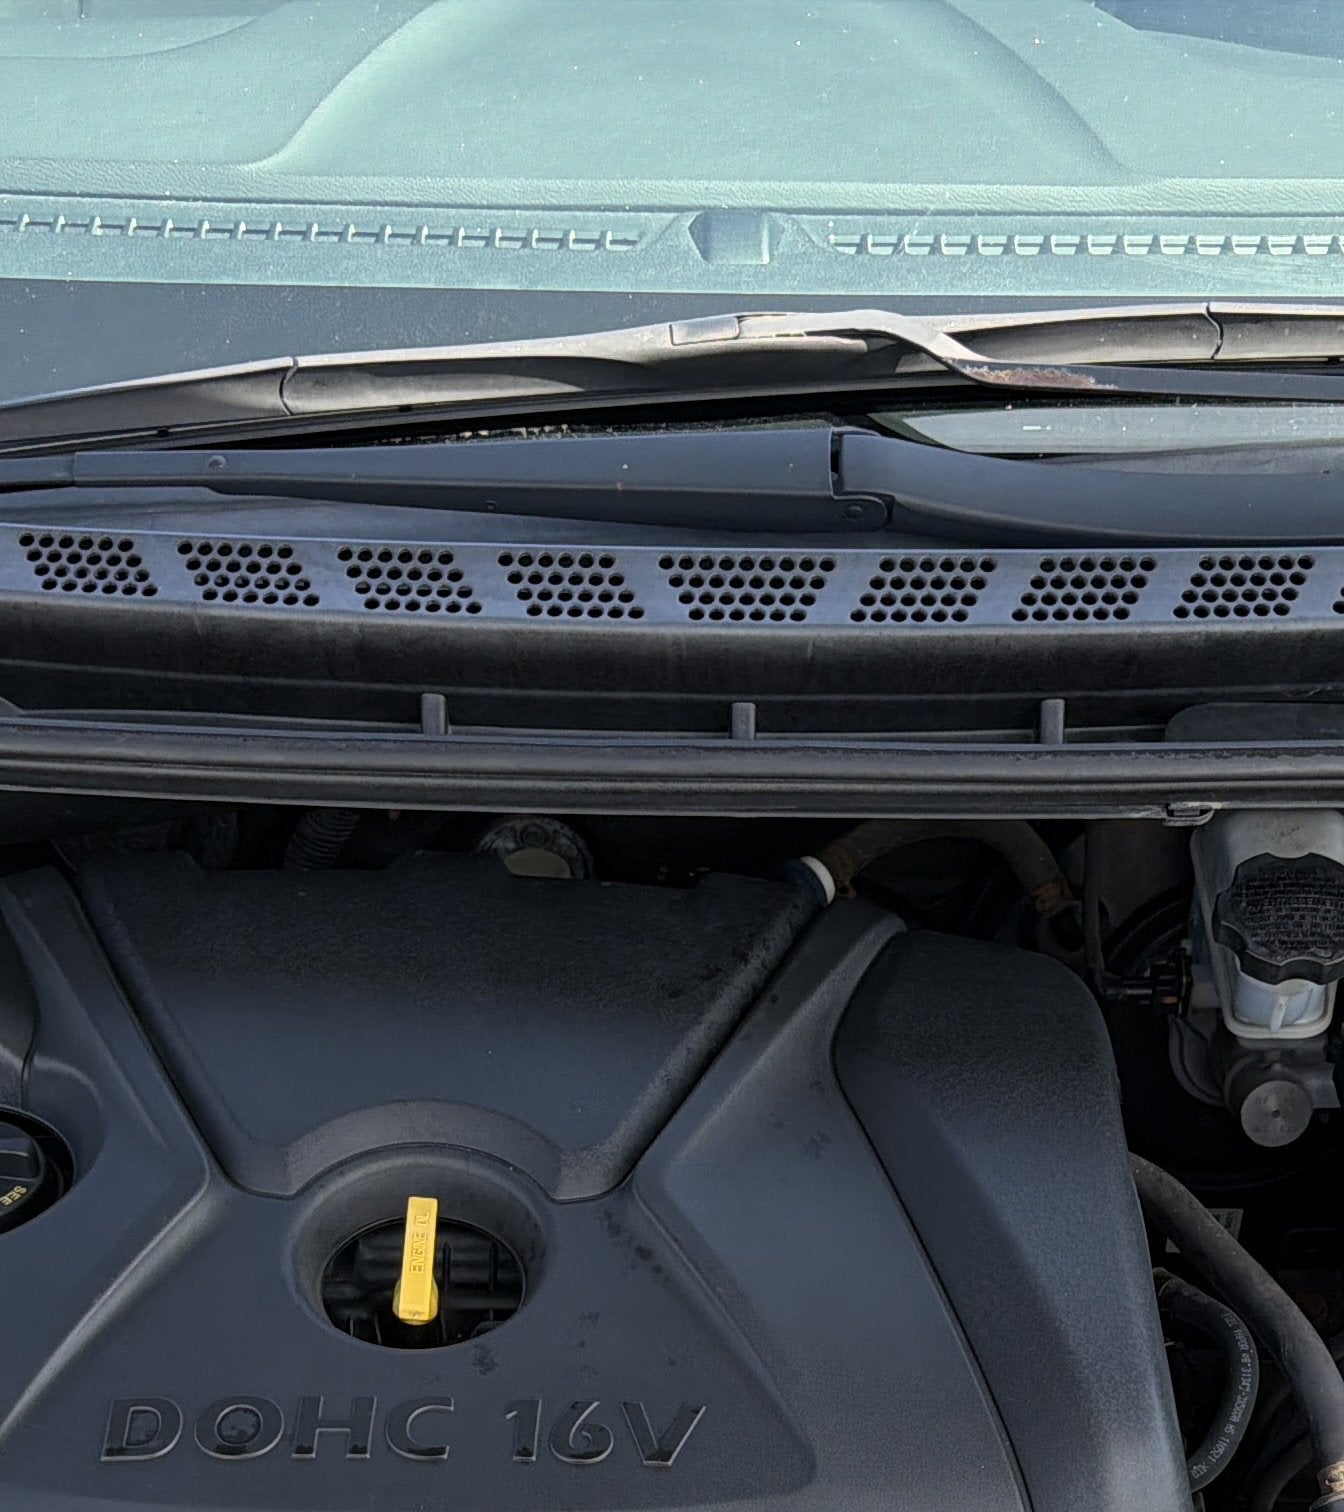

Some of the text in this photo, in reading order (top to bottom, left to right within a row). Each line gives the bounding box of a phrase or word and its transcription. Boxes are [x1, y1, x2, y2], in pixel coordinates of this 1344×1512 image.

[0, 1184, 28, 1207] SEE
[100, 1394, 707, 1468] DOHC 16V
